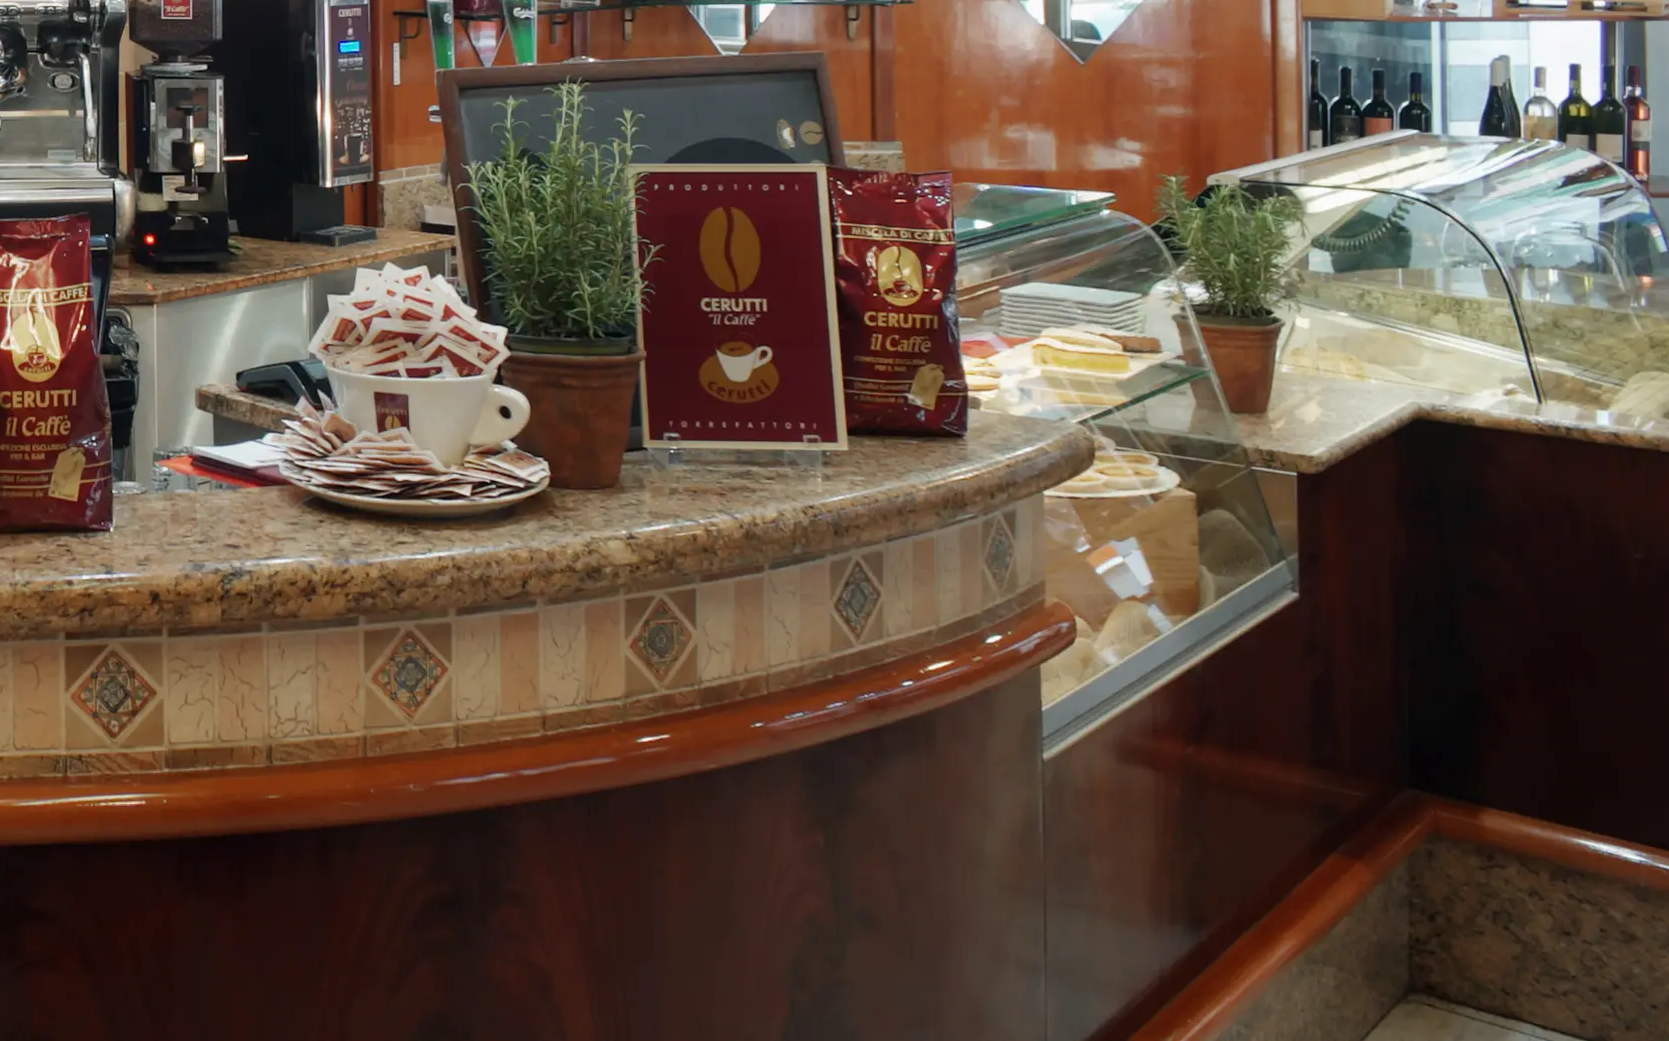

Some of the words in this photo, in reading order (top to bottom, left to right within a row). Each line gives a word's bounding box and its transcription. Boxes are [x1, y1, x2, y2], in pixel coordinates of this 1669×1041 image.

[653, 183, 800, 192] PRODUTTORI
[900, 230, 912, 239] DI
[700, 297, 768, 312] CERUTTI
[863, 311, 939, 329] CERUTTI
[869, 333, 883, 351] il
[885, 334, 932, 353] Caffè
[707, 379, 771, 401] cerutti
[5, 416, 18, 437] il
[21, 414, 72, 437] Caffè
[668, 420, 818, 430] TORREFATTORI
